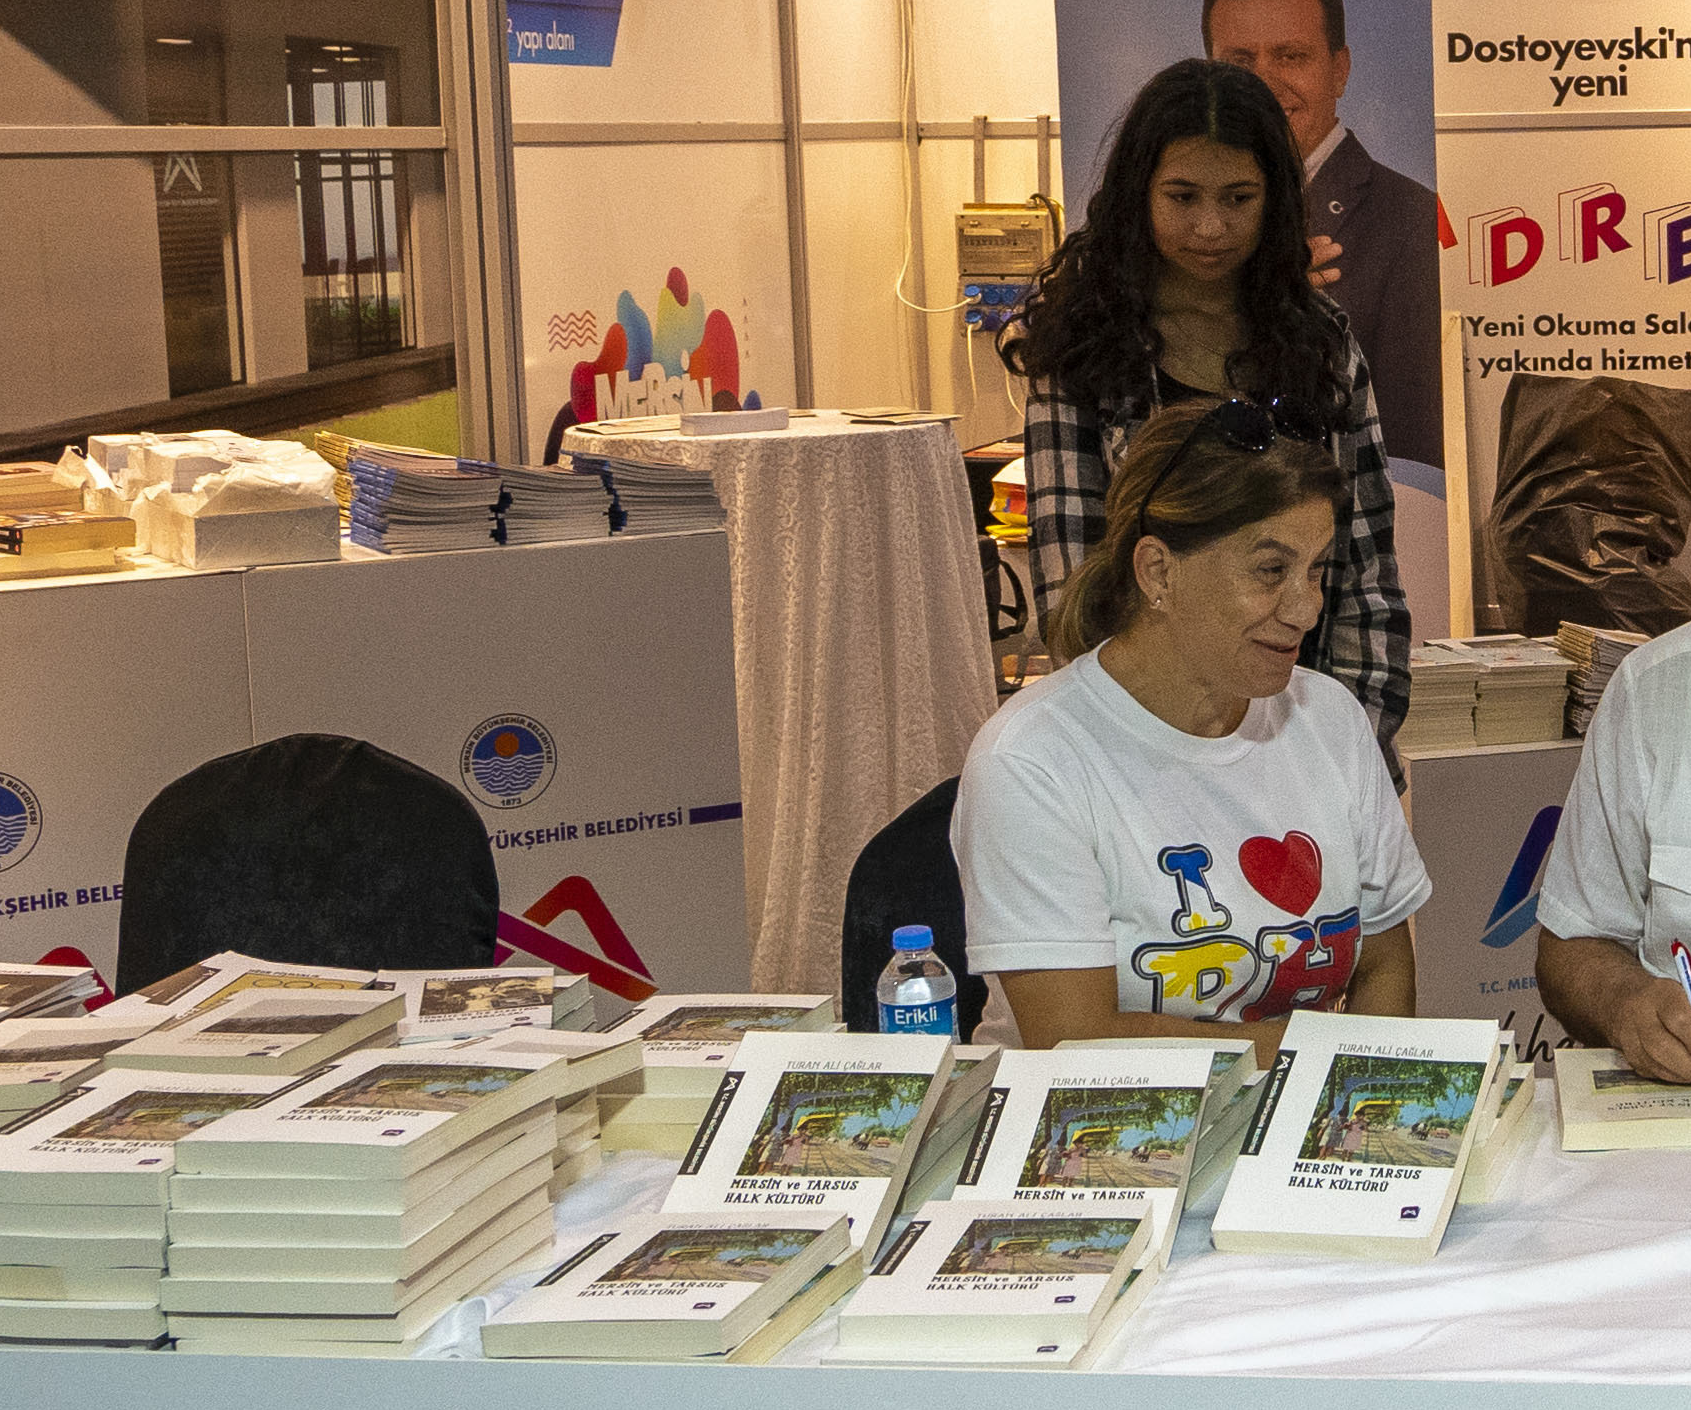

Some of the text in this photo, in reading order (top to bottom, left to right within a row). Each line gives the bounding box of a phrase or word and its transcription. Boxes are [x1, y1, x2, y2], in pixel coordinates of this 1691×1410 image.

[516, 21, 575, 57] yapı alanı
[1550, 68, 1628, 107] yeni
[1466, 315, 1524, 337] Yeni
[1534, 314, 1635, 336] Okuma
[1479, 349, 1592, 379] yakında
[500, 797, 522, 807] 1873
[585, 807, 683, 838] BELEDİYESİ
[1157, 844, 1231, 938] I
[1479, 982, 1504, 994] T.C.
[895, 1006, 937, 1025] Erikli
[1338, 1044, 1433, 1058] TURAN ALİ ÇAĞLAR
[787, 1060, 882, 1072] TURAN ALİ ÇAĞLAR
[1051, 1076, 1149, 1087] TURAN ALİ ÇAĞLAR
[1293, 1162, 1422, 1179] MERSİN ve TARSUS
[731, 1177, 859, 1191] MERSİN ve TARSUS
[1288, 1176, 1389, 1192] HALK KÜLTÜRÜ
[724, 1191, 825, 1205] HALK KÜLTÜRÜ
[1014, 1190, 1145, 1201] MERSİN ve TARSUS
[588, 1280, 729, 1291] MERSİN TARSUS
[577, 1288, 689, 1298] HALK KÜLTÜRÜ
